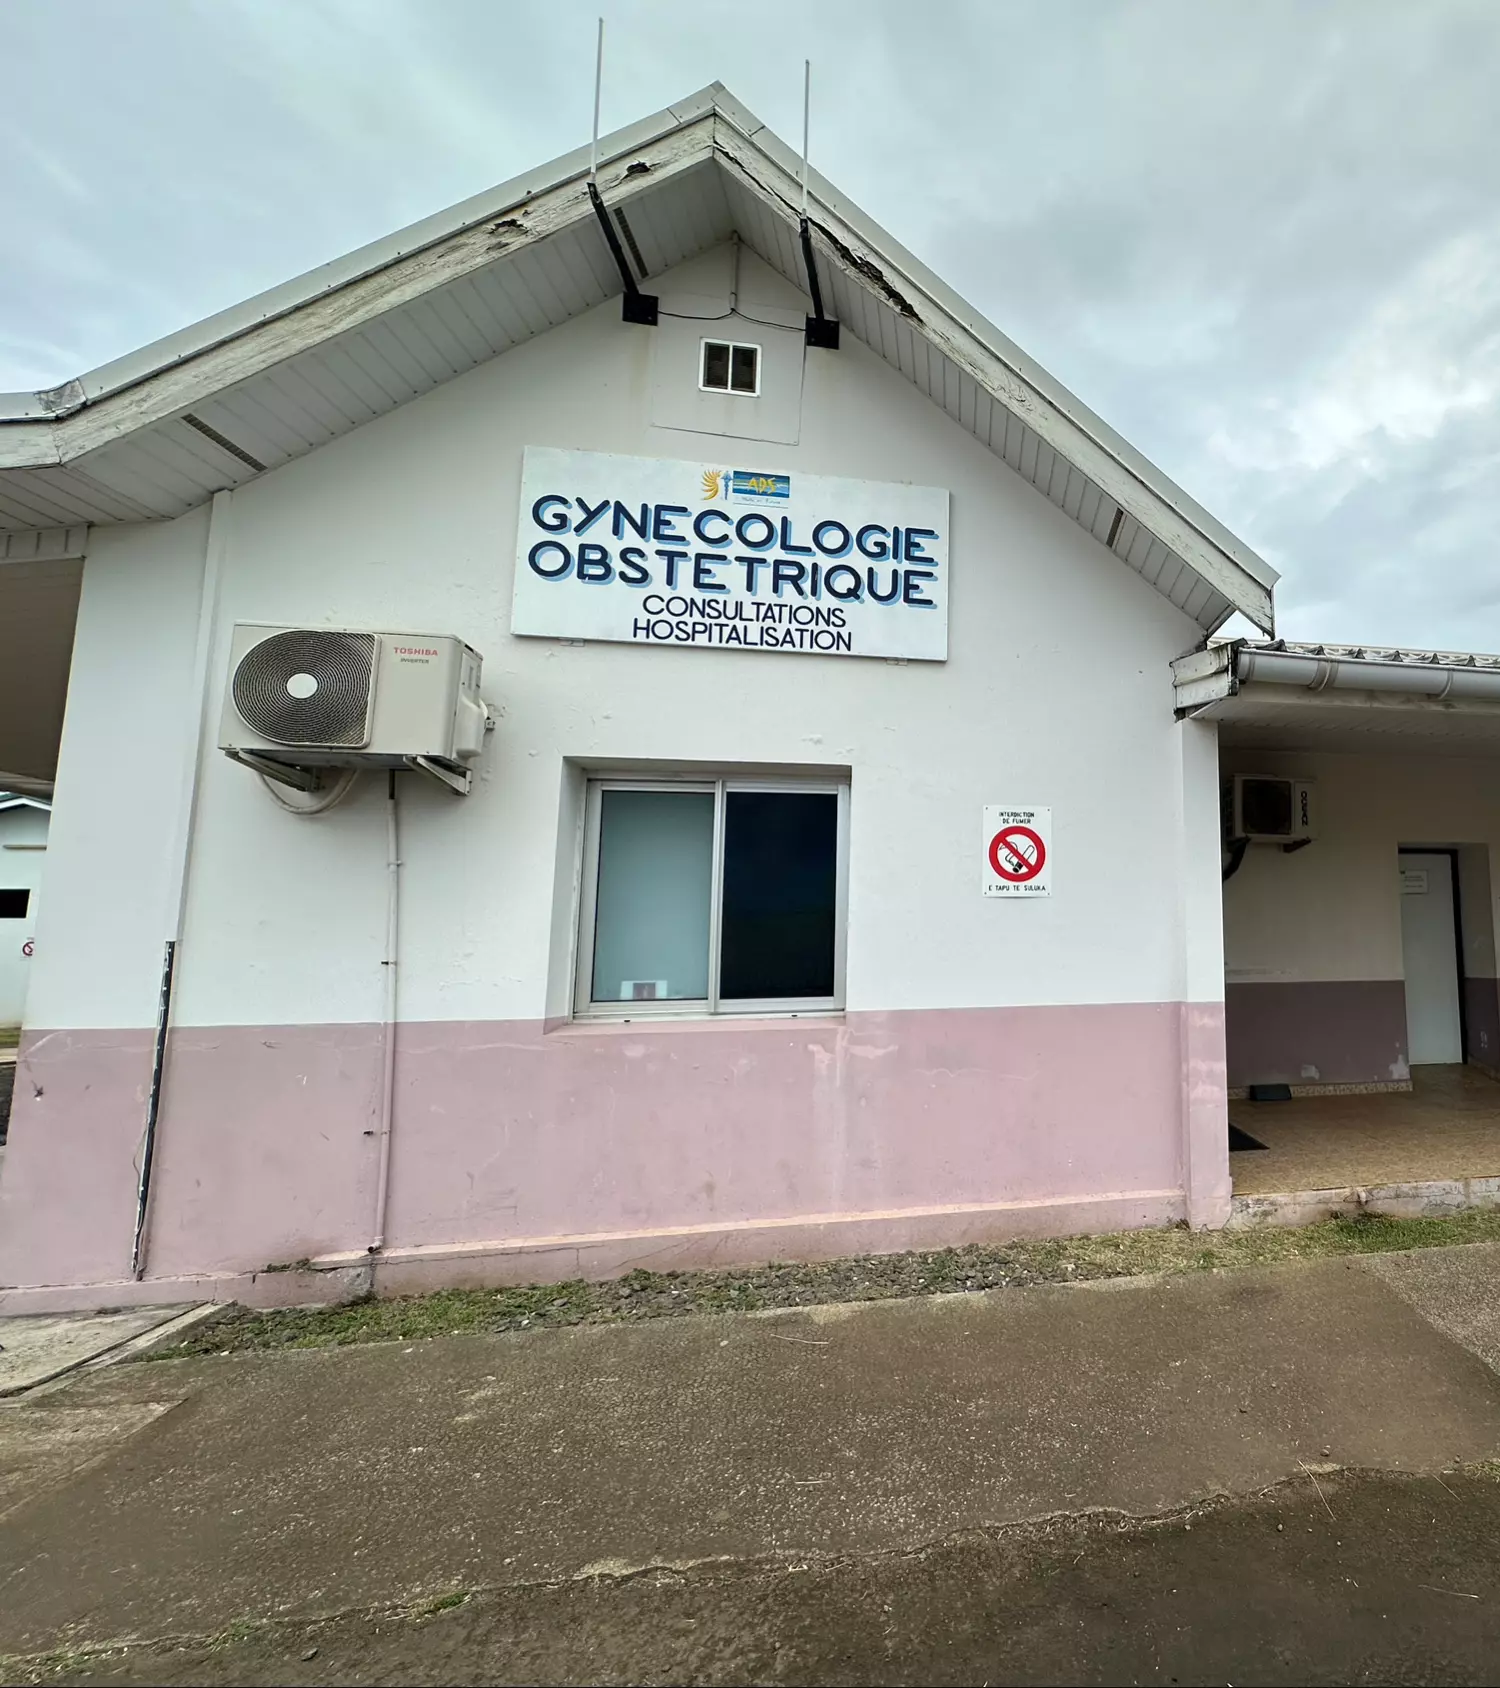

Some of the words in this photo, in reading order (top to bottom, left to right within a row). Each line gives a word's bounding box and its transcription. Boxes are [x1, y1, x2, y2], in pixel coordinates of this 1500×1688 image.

[748, 477, 777, 494] ADS
[532, 494, 939, 567] GYNECOLOGIE
[528, 540, 938, 609] OBSTETRIQUE
[642, 594, 847, 628] CONSULTATIONS
[394, 647, 438, 656] TOSHIBA
[632, 619, 852, 652] HOSPITALISATION
